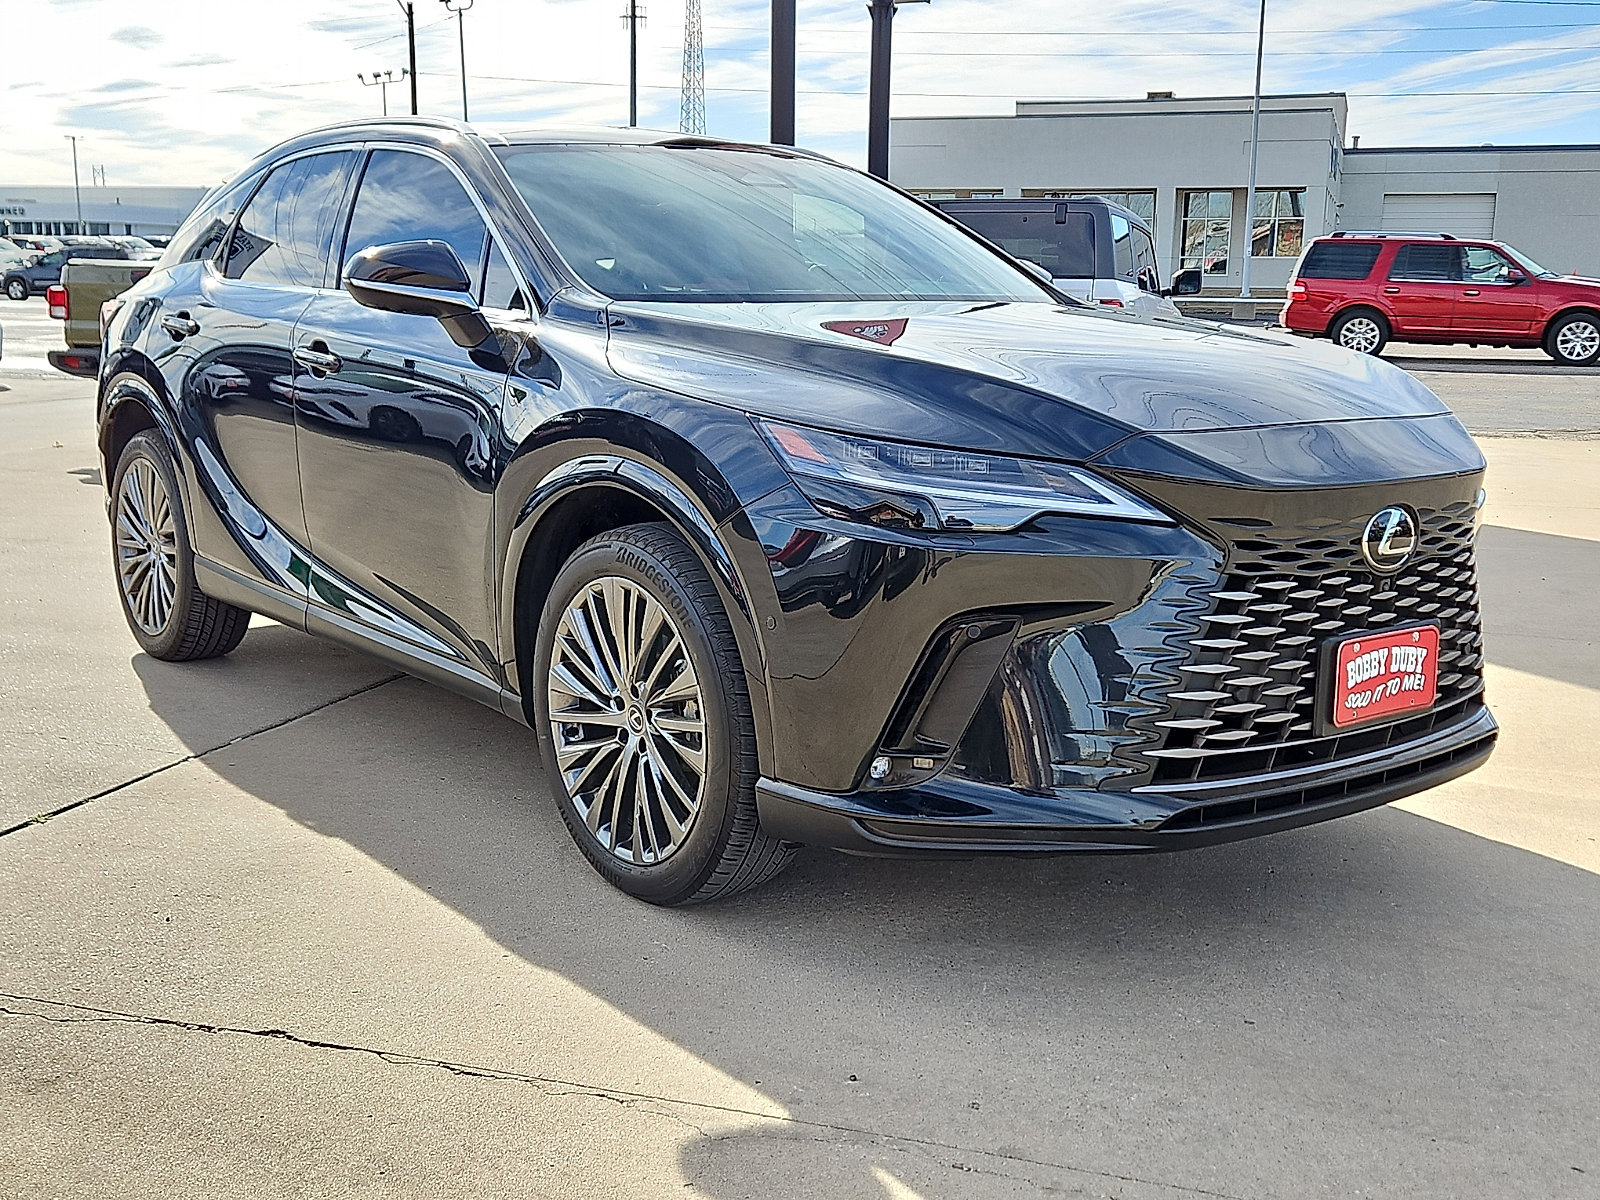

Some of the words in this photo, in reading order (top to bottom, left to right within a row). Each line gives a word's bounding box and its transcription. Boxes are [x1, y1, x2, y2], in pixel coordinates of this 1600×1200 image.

[615, 546, 696, 630] BRIDGESTONE
[1346, 647, 1389, 690] BOBBY
[1390, 645, 1428, 674] DUBY
[1344, 690, 1371, 709] SOLD
[1372, 684, 1386, 704] IT
[1385, 677, 1401, 698] TO
[1401, 673, 1426, 692] ME!
